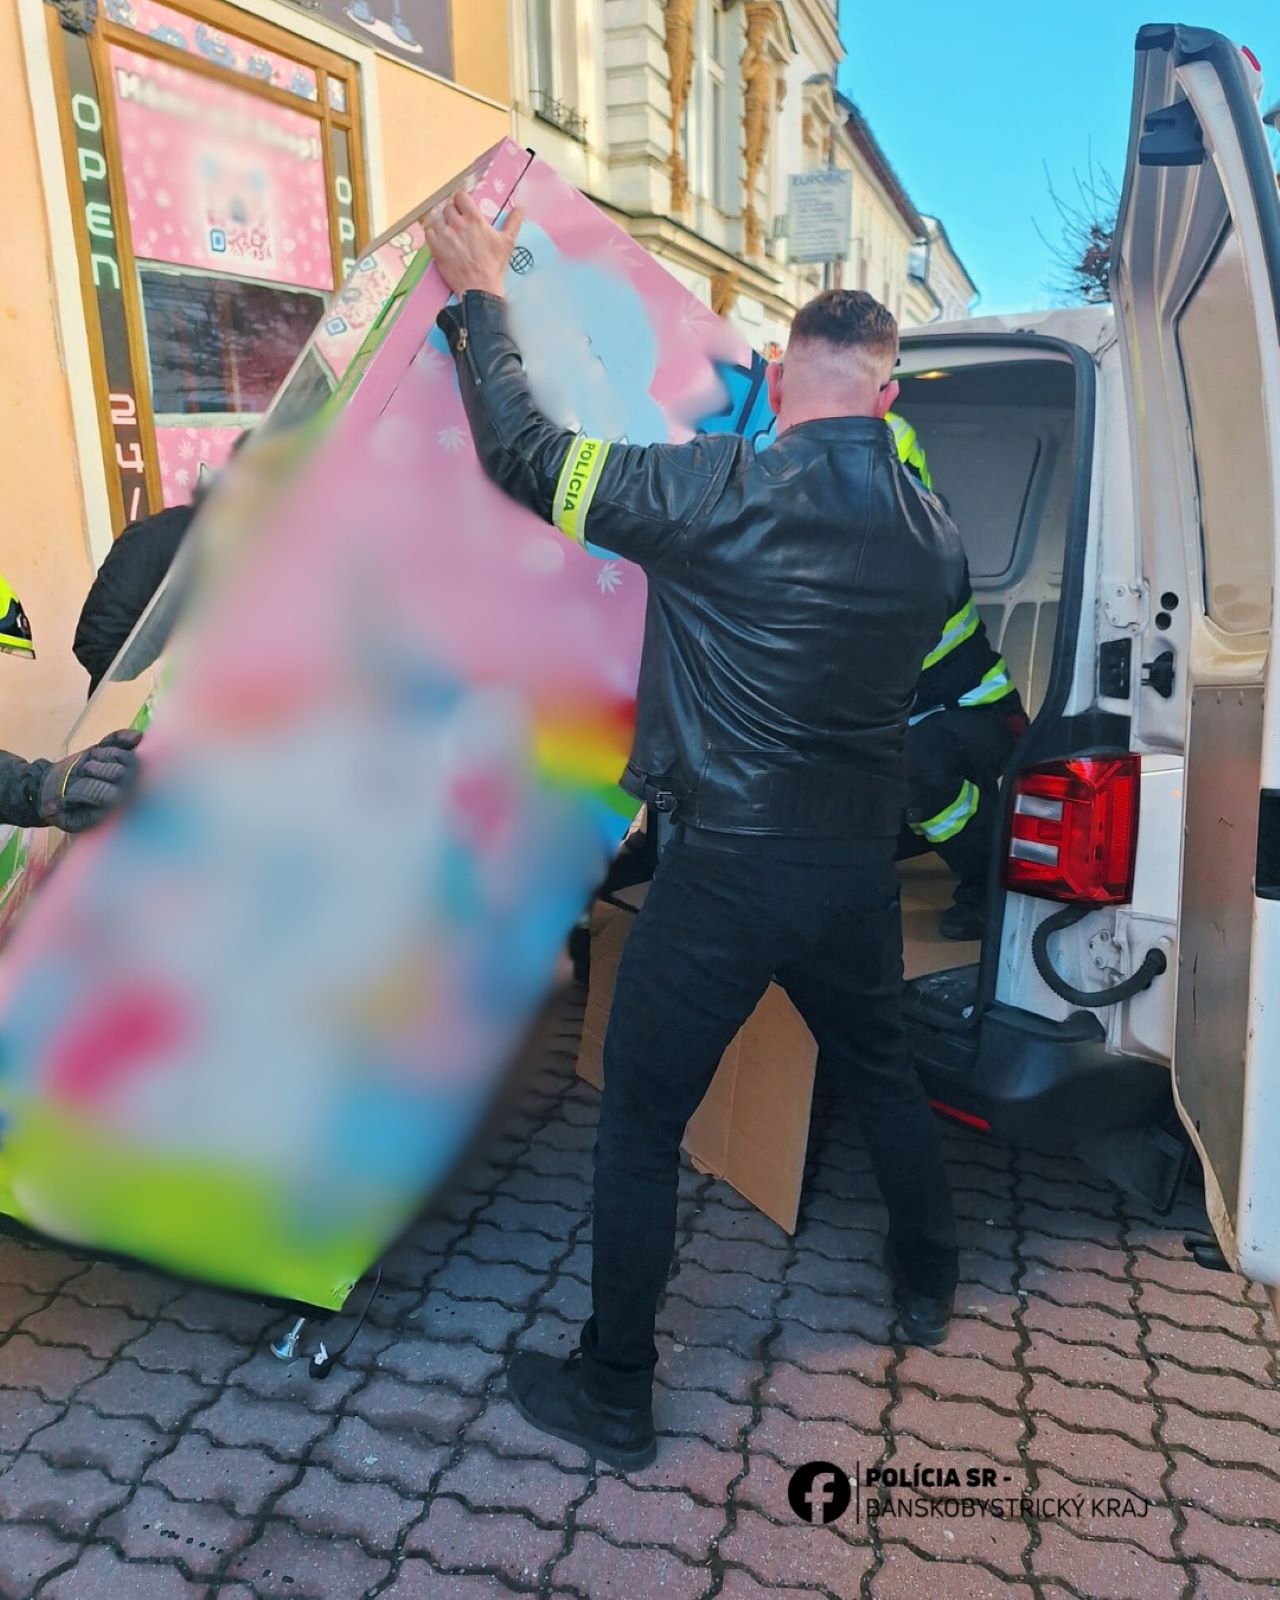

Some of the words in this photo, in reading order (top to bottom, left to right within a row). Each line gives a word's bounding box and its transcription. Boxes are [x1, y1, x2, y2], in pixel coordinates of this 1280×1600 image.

[334, 175, 356, 280] OPE
[109, 393, 144, 521] 24/
[563, 442, 597, 512] POLÍCIA
